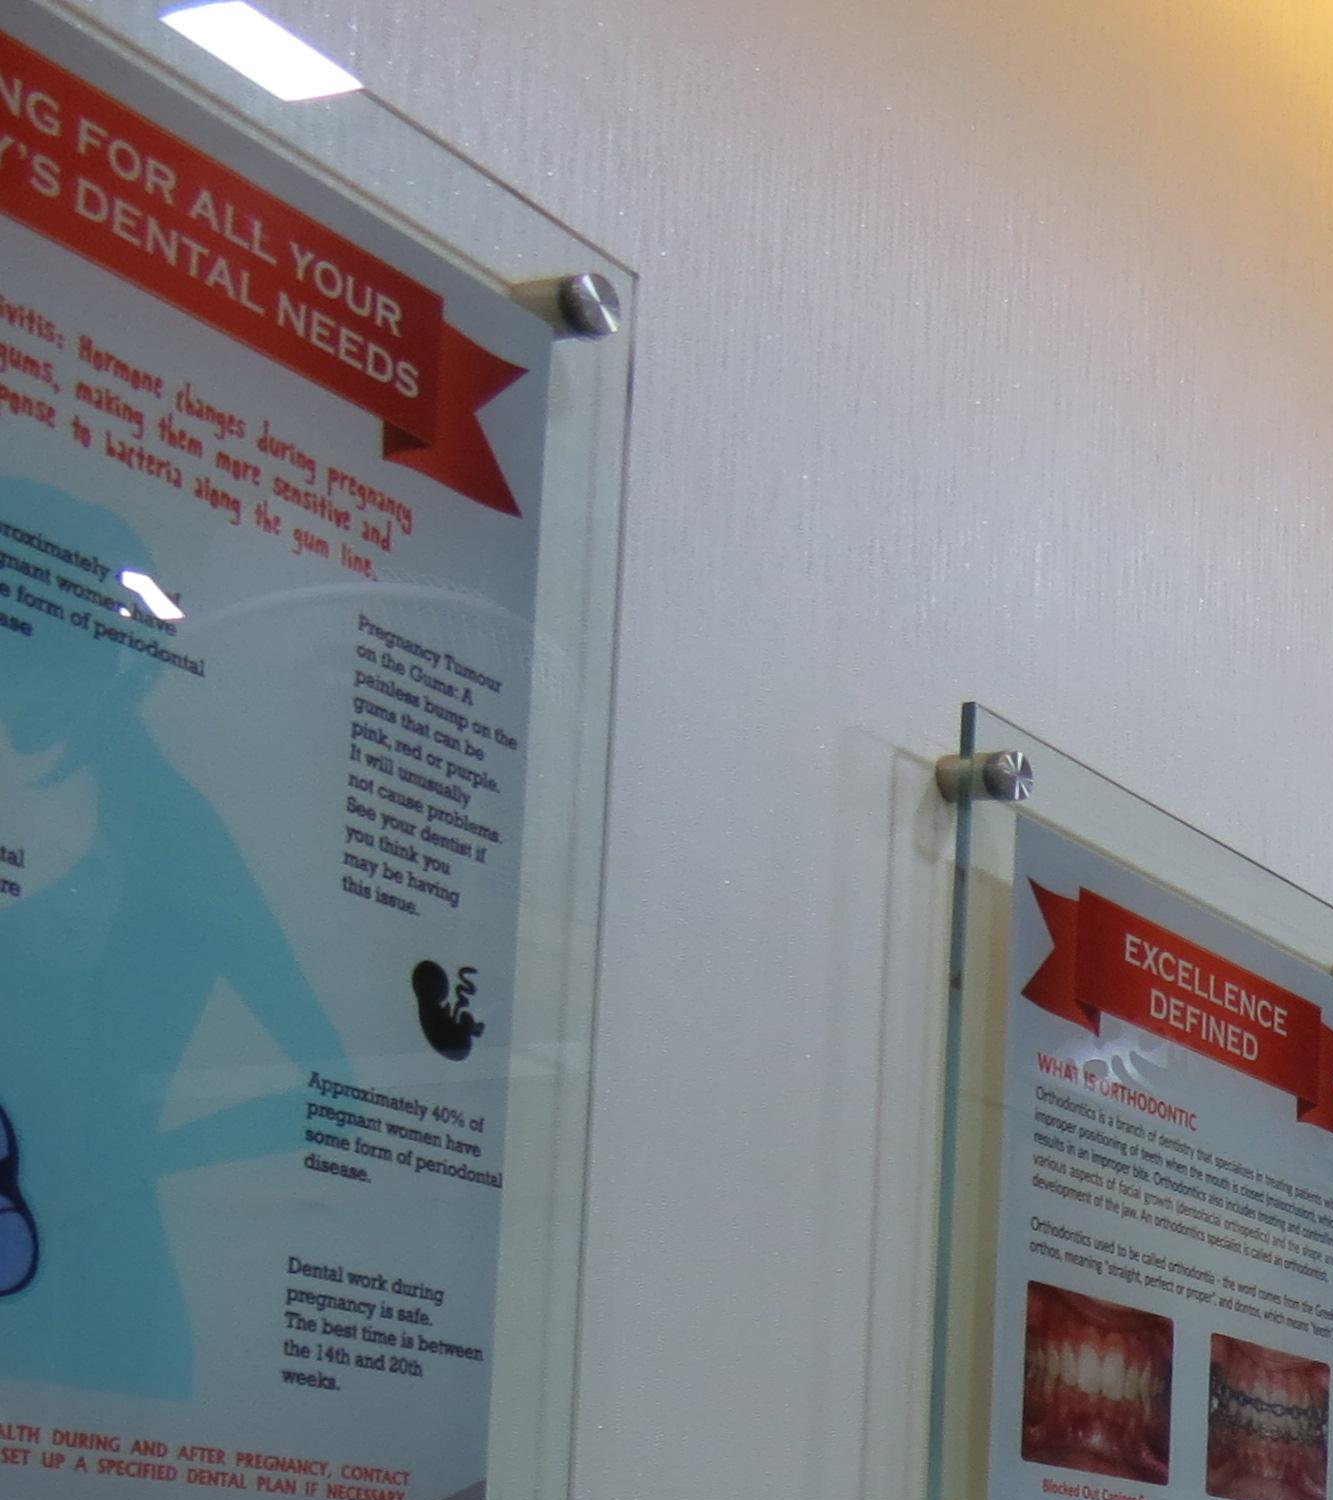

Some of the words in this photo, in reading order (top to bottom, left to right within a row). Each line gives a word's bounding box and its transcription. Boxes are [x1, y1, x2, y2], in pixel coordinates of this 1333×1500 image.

[77, 117, 176, 206] FOR
[188, 190, 277, 266] ALL
[289, 241, 402, 338] YOUR
[75, 177, 265, 317] DENTAL
[276, 290, 420, 399] NEEDS
[79, 335, 164, 399] Hormone
[176, 382, 246, 440] changes
[257, 420, 316, 485] during
[327, 466, 413, 535] pregnancy
[75, 381, 145, 440] making
[158, 412, 204, 459] them
[216, 451, 261, 486] more
[273, 476, 351, 530] sensitive
[361, 521, 391, 552] and
[72, 414, 92, 448] to
[105, 429, 183, 488] bacteria
[193, 477, 242, 526] along
[255, 500, 281, 535] the
[291, 528, 329, 558] gum
[341, 543, 379, 582] line.
[16, 584, 64, 621] form
[70, 611, 91, 630] of
[93, 621, 205, 678] periodontal
[358, 613, 441, 669] Pregnancy
[444, 653, 503, 695] Tumour
[356, 644, 377, 664] on
[381, 653, 405, 676] the
[461, 687, 474, 707] A
[353, 696, 398, 724] gums
[401, 714, 430, 739] that
[434, 731, 461, 751] can
[465, 740, 485, 761] be
[354, 670, 420, 708] painless
[423, 696, 470, 732] bump
[472, 721, 492, 740] on
[494, 727, 518, 750] the
[350, 743, 362, 762] It
[365, 752, 394, 776] will
[395, 739, 422, 761] red
[426, 752, 443, 769] or
[445, 761, 500, 793] purple.
[346, 796, 376, 821] See
[381, 812, 417, 836] your
[420, 826, 473, 858] dentist
[475, 847, 488, 864] if
[348, 774, 374, 794] not
[378, 785, 424, 813] cause
[426, 804, 504, 845] problems.
[343, 852, 378, 878] may
[382, 862, 403, 884] be
[407, 871, 460, 908] having
[345, 826, 375, 847] you
[379, 836, 420, 863] think
[422, 854, 451, 875] you
[342, 875, 372, 899] this
[1124, 933, 1288, 1037] EXCELLENCE
[1150, 988, 1259, 1062] DEFINED
[307, 1071, 429, 1122] Approximately
[431, 1104, 466, 1128] 40%
[469, 1117, 485, 1133] of
[1037, 1053, 1079, 1084] WHAT
[1084, 1072, 1095, 1090] IS
[1099, 1079, 1198, 1131] ORTHODONTIC
[305, 1128, 350, 1151] some
[354, 1137, 393, 1162] form
[396, 1149, 413, 1166] of
[414, 1155, 503, 1189] periodontal
[306, 1101, 383, 1133] pregnant
[385, 1121, 442, 1147] women
[445, 1134, 482, 1158] have
[303, 1153, 372, 1184] disease.
[286, 1287, 377, 1319] pregnancy
[379, 1301, 394, 1320] is
[397, 1307, 434, 1327] safe.
[287, 1256, 343, 1284] Dental
[347, 1271, 388, 1292] work
[391, 1278, 445, 1306] during
[283, 1339, 310, 1359] the
[316, 1344, 351, 1365] 14th
[355, 1353, 386, 1372] and
[389, 1355, 423, 1378] 20th
[285, 1311, 317, 1333] The
[321, 1318, 358, 1340] best
[362, 1325, 397, 1346] time
[401, 1331, 415, 1350] is
[417, 1334, 485, 1362] between
[281, 1368, 341, 1391] weeks.
[1, 1448, 32, 1466] SET
[41, 1452, 65, 1469] UP
[74, 1455, 87, 1472] A
[97, 1458, 179, 1482] SPECIFIED
[186, 1469, 248, 1490] DENTAL
[256, 1475, 297, 1495] PLAN
[305, 1482, 319, 1495] IF
[52, 1429, 121, 1453] DURING
[130, 1439, 168, 1458] AND
[177, 1445, 226, 1465] AFTER
[235, 1451, 332, 1478] PREGNANCY,
[341, 1465, 411, 1487] CONTACT
